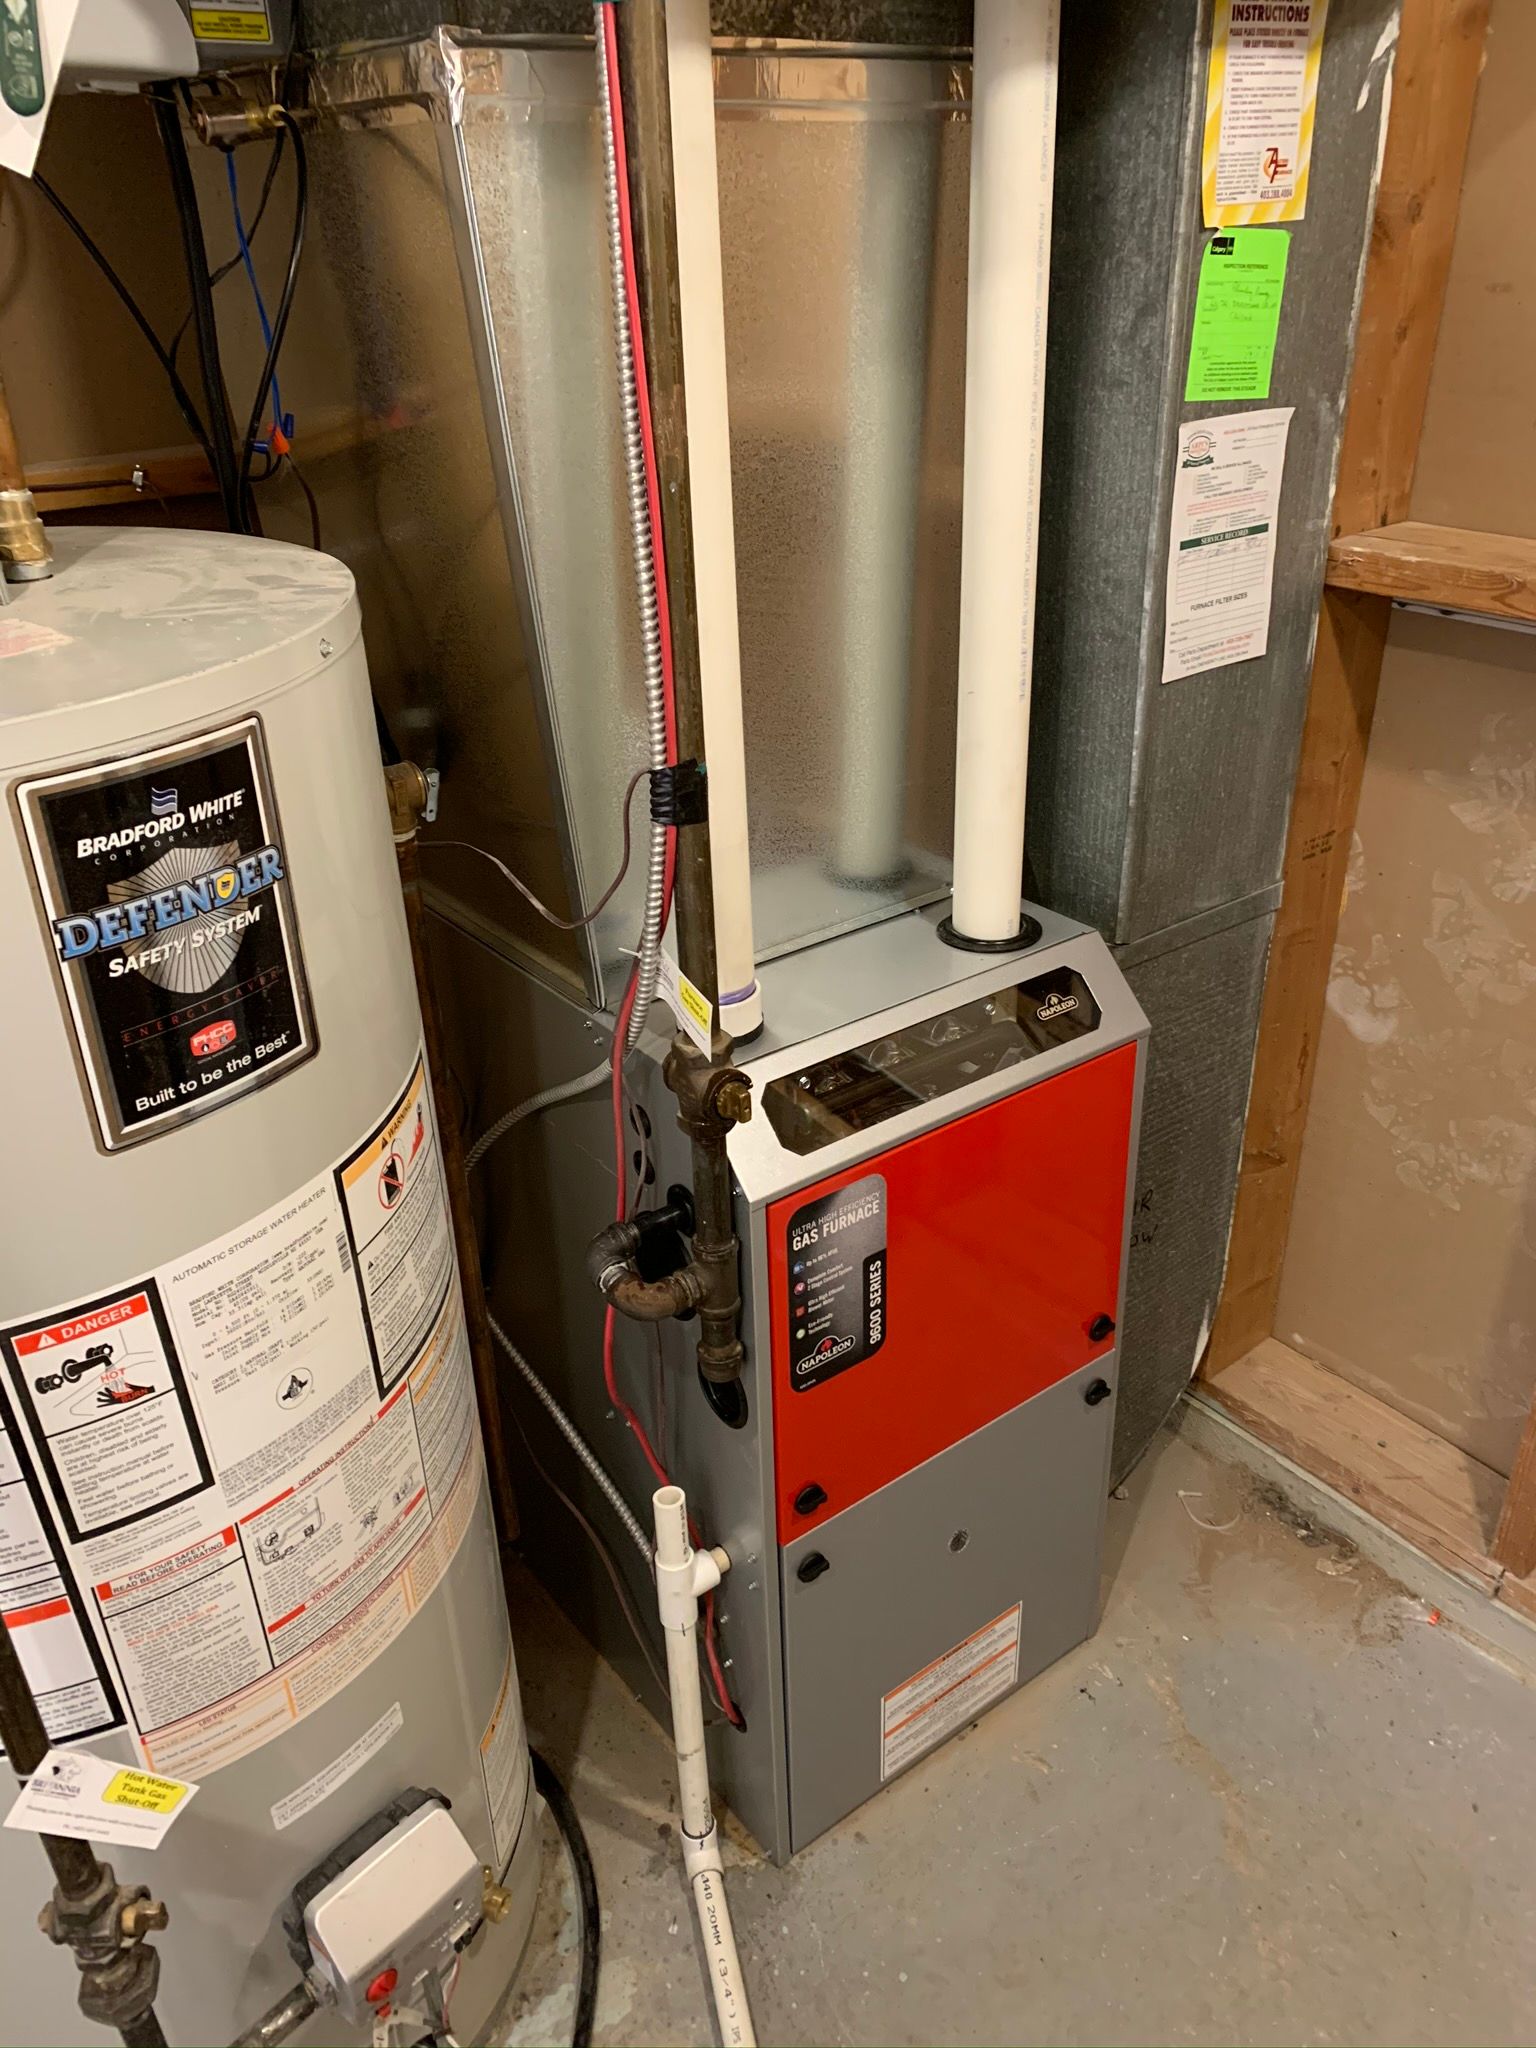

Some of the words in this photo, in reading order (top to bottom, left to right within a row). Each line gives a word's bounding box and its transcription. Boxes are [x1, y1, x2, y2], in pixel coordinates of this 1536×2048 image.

[1232, 5, 1310, 22] INSTRUCTIONS
[1200, 534, 1225, 545] SERVICE
[1226, 528, 1249, 541] RECORD
[1190, 600, 1214, 611] FURNACE
[1215, 596, 1232, 604] FILTER
[1234, 592, 1248, 601] SIZES
[76, 812, 185, 859] BRADFORD
[188, 789, 243, 823] WHITE
[94, 813, 236, 866] CORPORATION
[56, 845, 284, 958] DEFENDER
[108, 939, 186, 978] SAFETY
[190, 908, 261, 950] SYSTEM
[122, 1003, 209, 1043] ENERGY
[221, 968, 281, 1003] SAVER
[1040, 999, 1076, 1018] NAPOLEON
[136, 1086, 177, 1112] Built
[178, 1077, 198, 1094] to
[201, 1067, 224, 1087] be
[226, 1055, 252, 1075] the
[254, 1032, 288, 1060] Best
[388, 1099, 412, 1139] WARNING
[792, 1220, 816, 1237] ULTRA
[818, 1210, 838, 1226] HIGH
[839, 1192, 881, 1216] EFFICIENCY
[792, 1227, 818, 1251] GAS
[823, 1200, 880, 1238] FURNACE
[172, 1251, 226, 1284] AUTOMATIC
[228, 1226, 268, 1256] STORAGE
[269, 1208, 298, 1230] WATER
[298, 1186, 326, 1211] HEATER
[870, 1260, 882, 1306] SERIES
[61, 1305, 133, 1340] DANGER
[870, 1309, 882, 1345] 9600
[801, 1339, 851, 1373] NAPOLEON
[100, 1367, 126, 1384] HOT
[120, 1388, 149, 1403] BURN
[56, 1434, 78, 1445] Water
[80, 1417, 124, 1437] temperature
[125, 1411, 141, 1419] over
[60, 1443, 91, 1458] instantly
[102, 1432, 122, 1441] death
[123, 1425, 139, 1433] from
[74, 1436, 96, 1445] cause
[98, 1426, 122, 1436] severe
[98, 1439, 128, 1453] disabled
[144, 1423, 167, 1434] elderly
[87, 1464, 124, 1480] instruction
[125, 1454, 151, 1465] manual
[152, 1443, 174, 1454] before
[88, 1451, 115, 1464] highest
[138, 1433, 158, 1444] being
[95, 1489, 115, 1497] water
[116, 1479, 139, 1490] before
[139, 1467, 166, 1480] bathing
[97, 1463, 141, 1482] temperature
[150, 1451, 169, 1460] water
[299, 1457, 334, 1486] OPERATING
[82, 1500, 128, 1518] Temperature
[113, 1580, 138, 1593] READ
[140, 1567, 174, 1585] BEFORE
[176, 1541, 224, 1570] OPERATING
[128, 1570, 146, 1581] FOR
[149, 1559, 173, 1573] YOUR
[174, 1543, 206, 1562] SAFETY
[122, 1783, 146, 1796] Tank
[149, 1788, 167, 1801] Gas
[124, 1771, 146, 1784] Hot
[147, 1776, 178, 1792] Water
[115, 1794, 160, 1810] Shut-Off
[707, 1906, 722, 1946] 20MM
